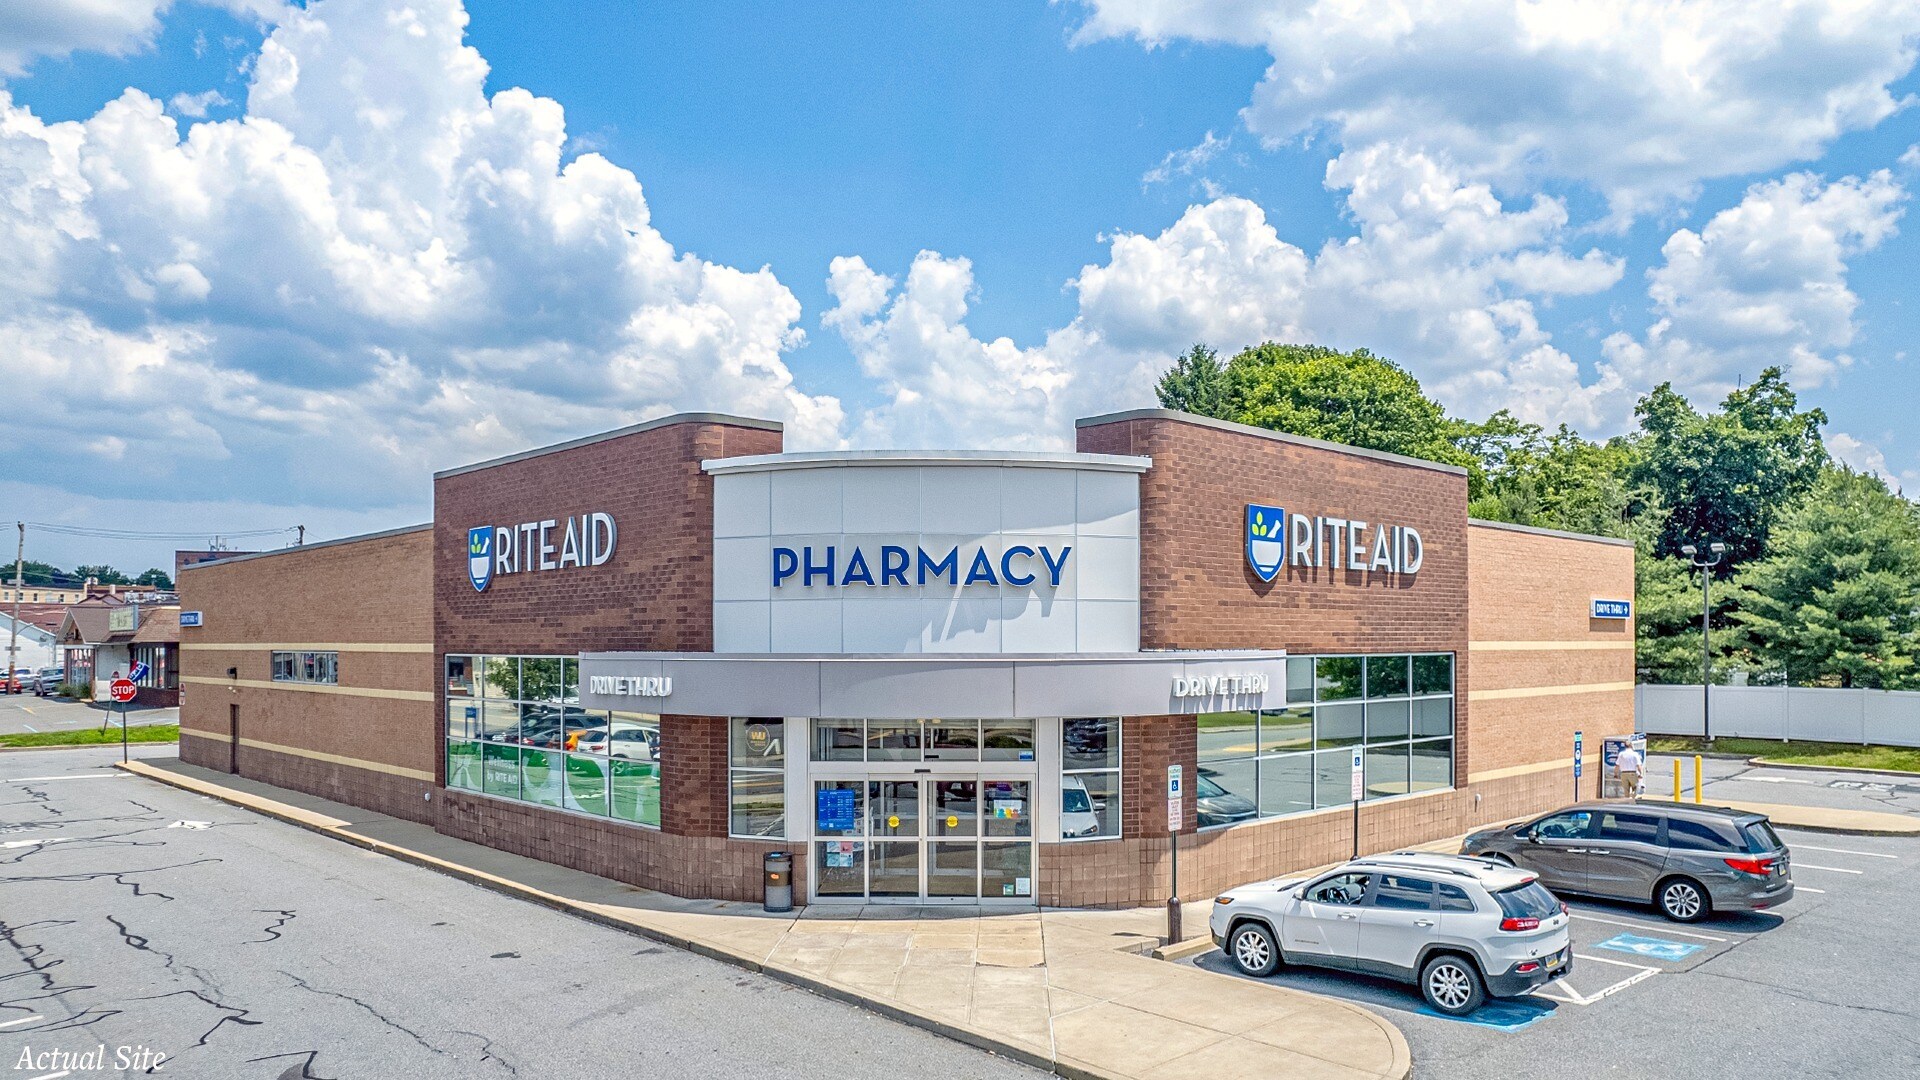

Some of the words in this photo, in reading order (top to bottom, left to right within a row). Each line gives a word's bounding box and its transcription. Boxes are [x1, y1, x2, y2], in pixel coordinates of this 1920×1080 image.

[772, 544, 1073, 587] PHARMACY
[112, 685, 135, 695] STOP
[590, 675, 627, 695] DRIVE
[626, 676, 673, 697] THRU
[1173, 674, 1229, 697] DRIVE
[1230, 673, 1268, 694] THRU
